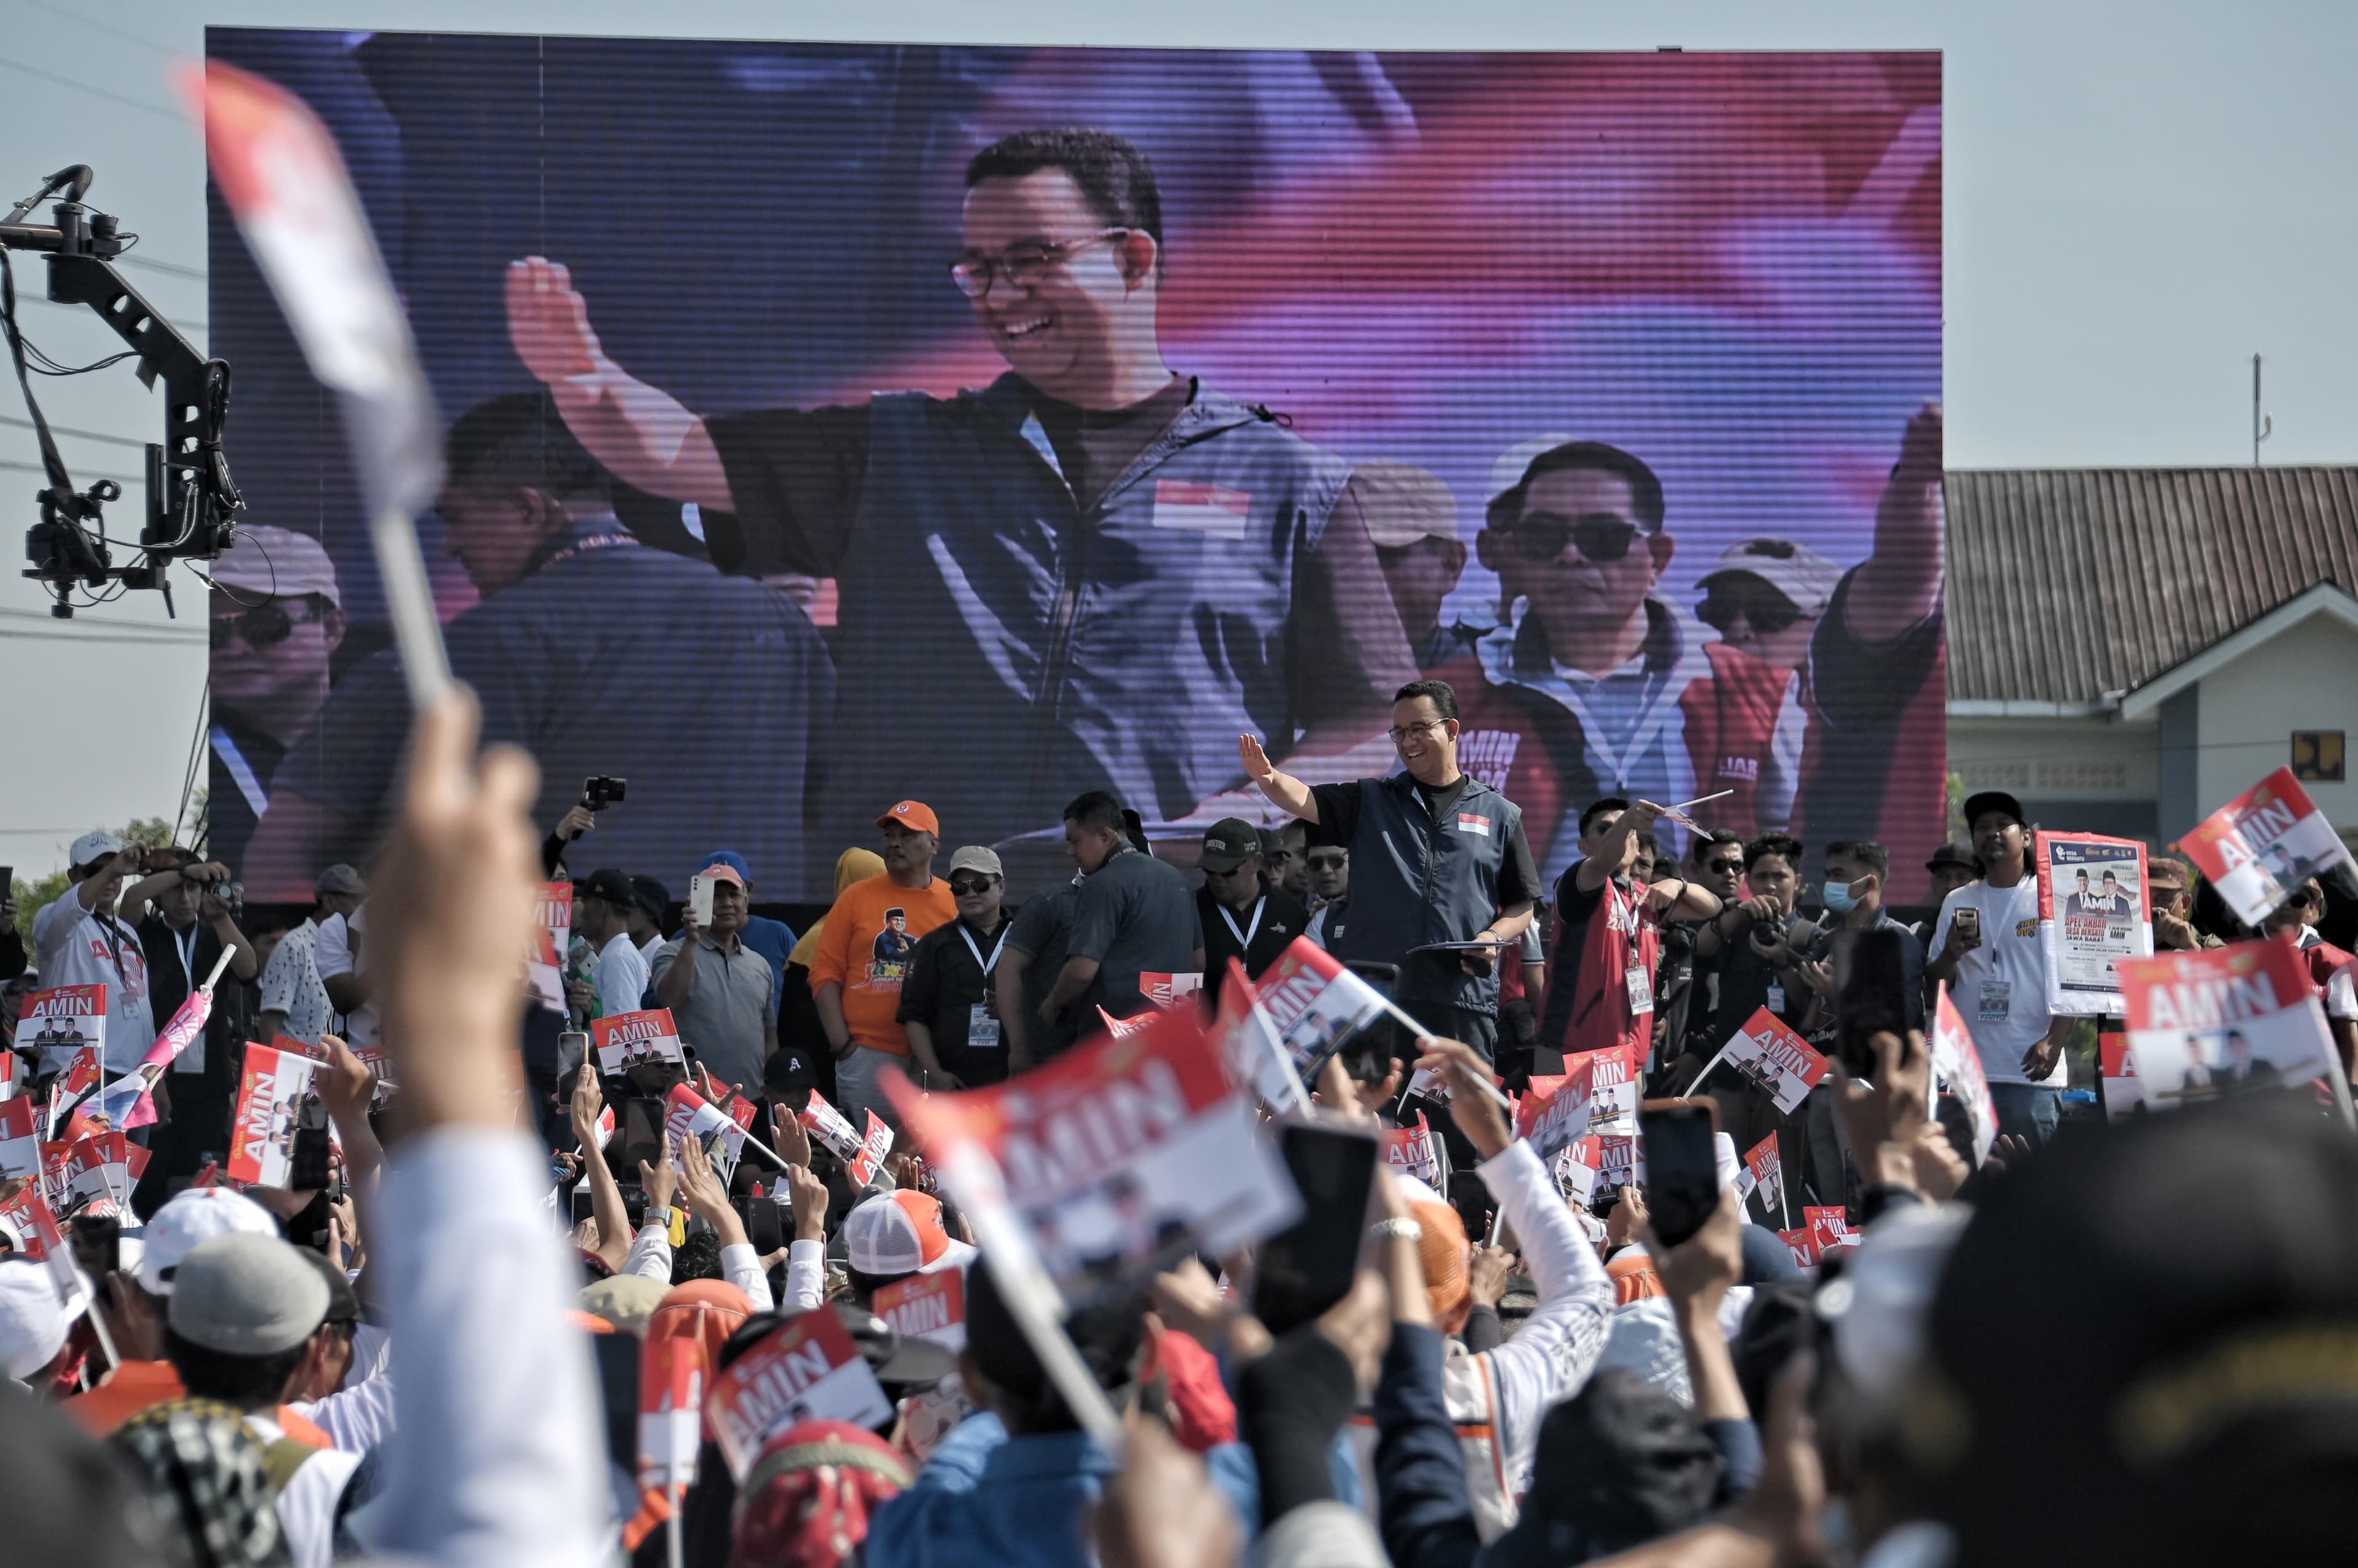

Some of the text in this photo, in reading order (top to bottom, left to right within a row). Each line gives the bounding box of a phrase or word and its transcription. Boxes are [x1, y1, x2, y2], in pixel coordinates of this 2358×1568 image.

[2216, 798, 2297, 871] AMIN
[2065, 917, 2082, 927] APEL
[2083, 897, 2115, 910] AMIN
[2110, 930, 2125, 939] AMIN
[31, 996, 92, 1017] AMIN
[1269, 964, 1328, 1032] MIN
[2152, 971, 2278, 1028] AMIN
[608, 1020, 663, 1046] AMIN
[1753, 1029, 1812, 1078] AMIN
[1592, 1060, 1627, 1087] MIN
[1767, 1055, 1780, 1066] 2024
[244, 1072, 276, 1165] AMIN
[1005, 1060, 1183, 1198] AMIN
[886, 1291, 949, 1336] AMIN
[728, 1340, 830, 1441] AMIN
